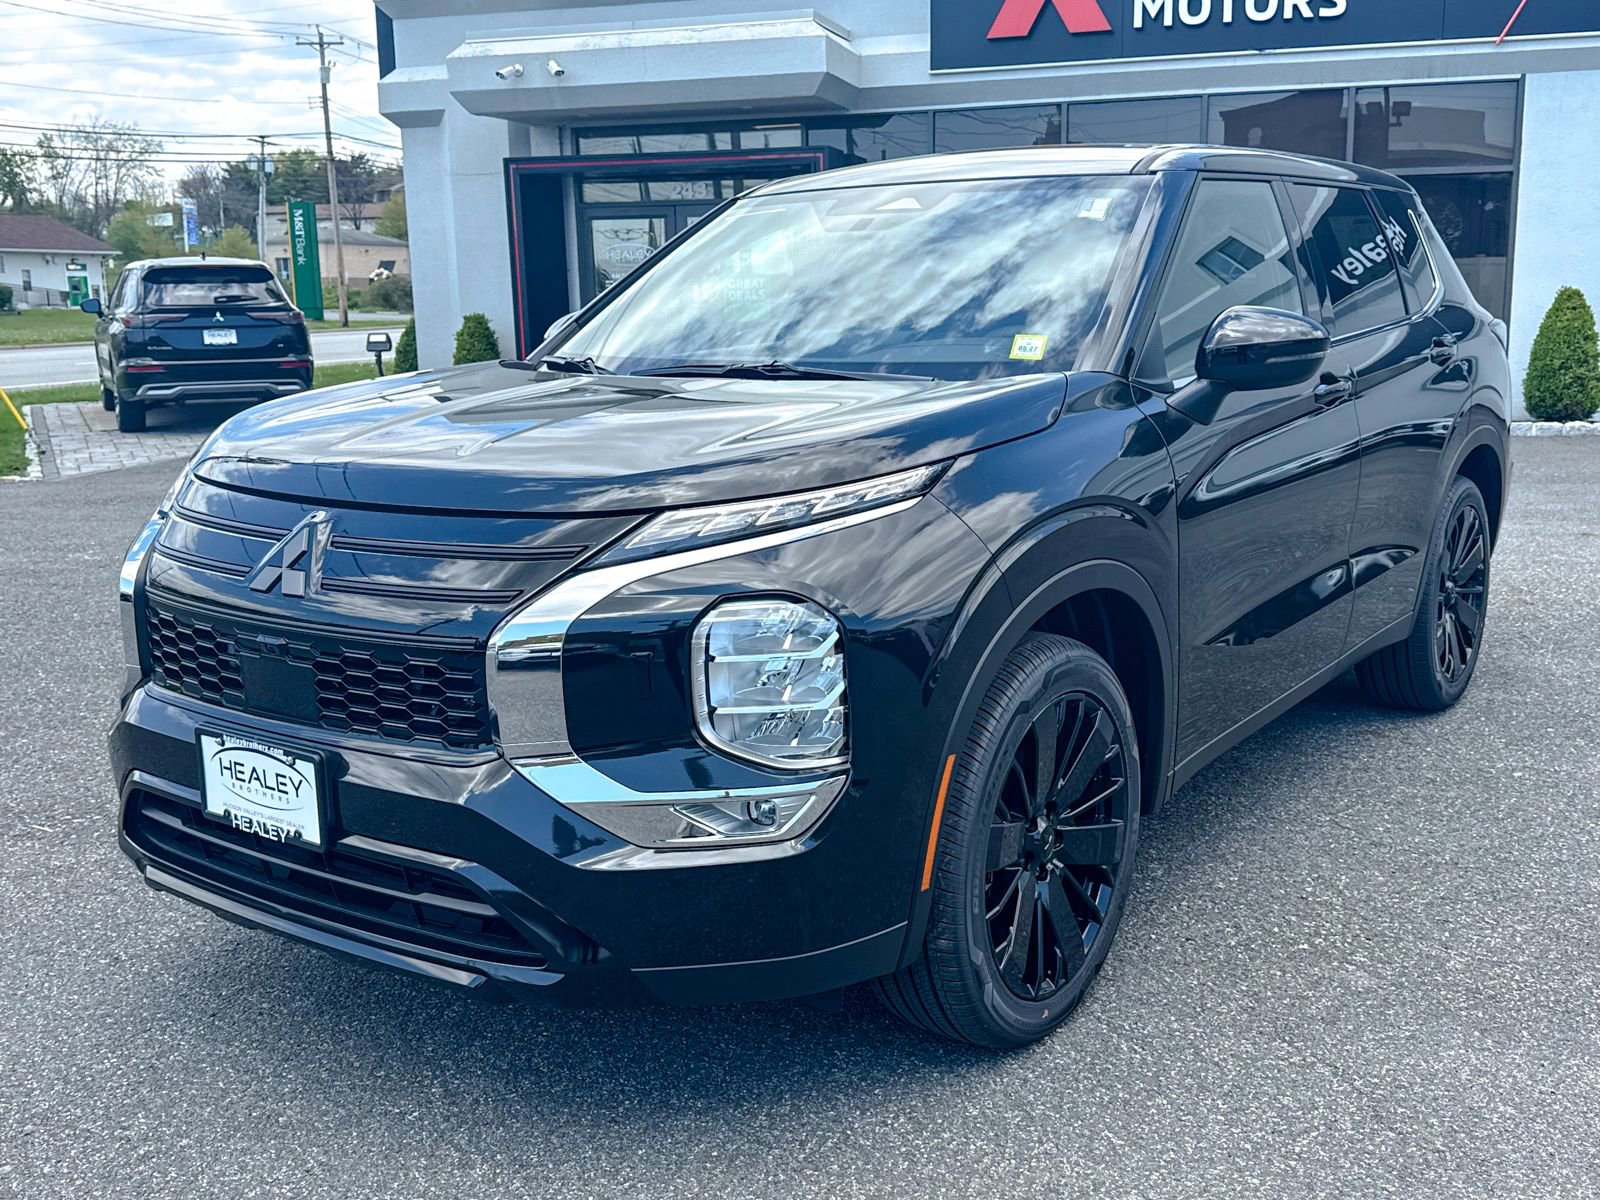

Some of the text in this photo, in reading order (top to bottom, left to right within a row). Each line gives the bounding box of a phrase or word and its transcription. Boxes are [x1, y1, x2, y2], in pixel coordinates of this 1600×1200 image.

[672, 182, 708, 200] 243
[293, 208, 307, 266] M&T Bank
[606, 247, 653, 260] HEALEY
[223, 734, 285, 756] healeybrothers.com
[219, 756, 303, 798] HEALEY
[231, 782, 291, 805] BROTHERS
[222, 801, 242, 812] HUDSON
[264, 813, 286, 825] LARGEST
[286, 819, 305, 831] DEALER
[232, 813, 288, 844] HEALEY
